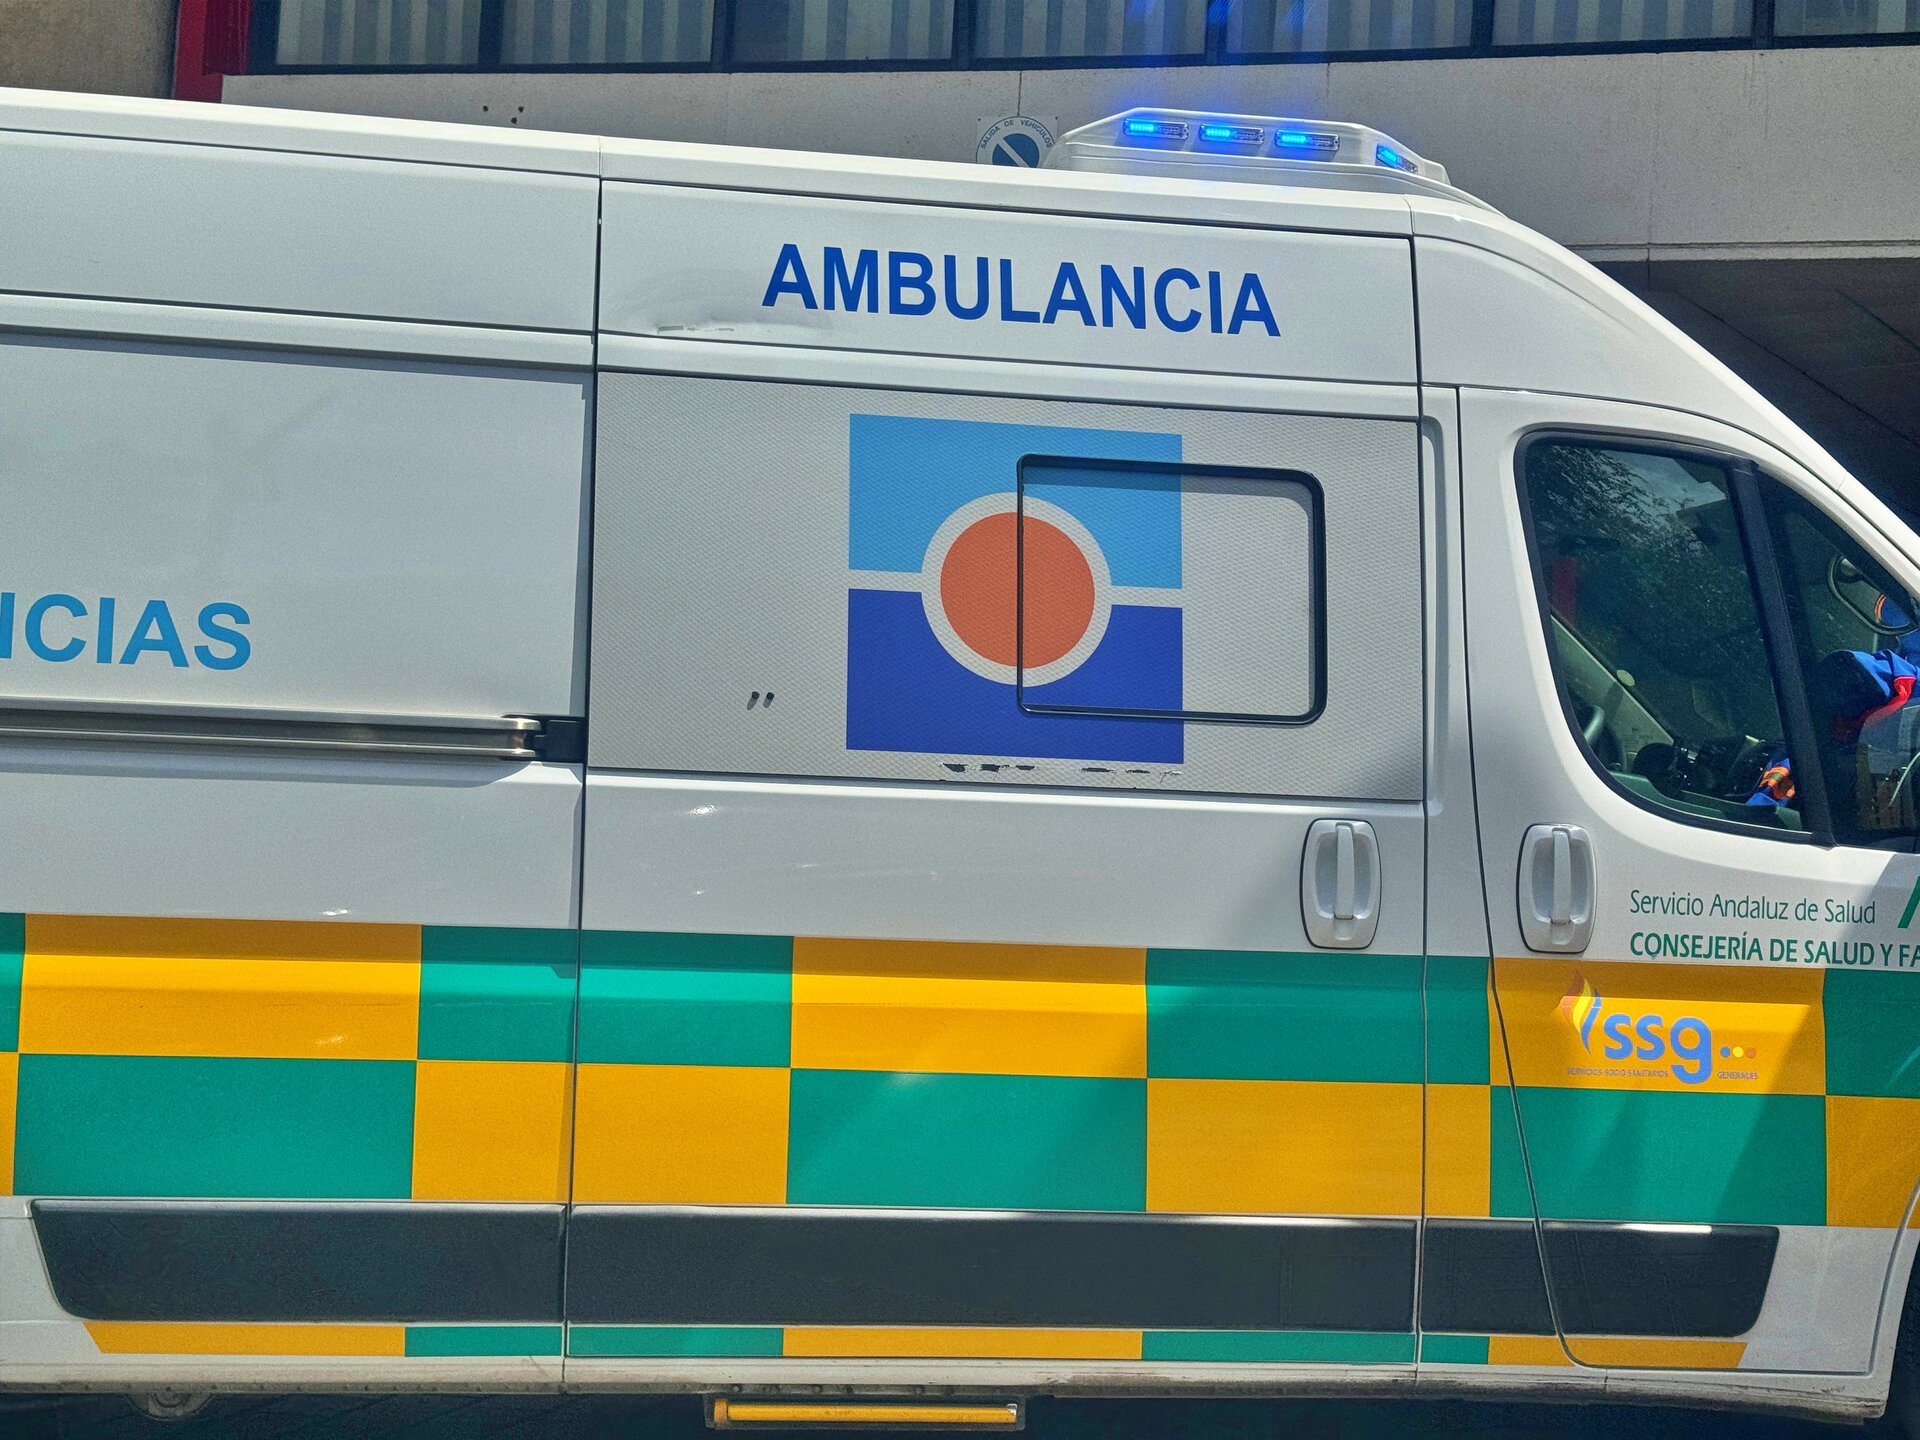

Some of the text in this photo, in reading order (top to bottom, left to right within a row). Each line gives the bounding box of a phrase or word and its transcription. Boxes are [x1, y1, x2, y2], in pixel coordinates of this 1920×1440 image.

[980, 126, 1000, 150] SALIDA
[762, 243, 1281, 337] AMBULANCIA
[1630, 889, 1876, 924] Servicio Andaluz de Salud
[1630, 931, 1763, 961] CONSEJERÍA
[1770, 938, 1798, 963] DE
[1804, 940, 1875, 965] SALUD
[1880, 943, 1893, 967] Y
[1604, 1069, 1626, 1077] SOCIO
